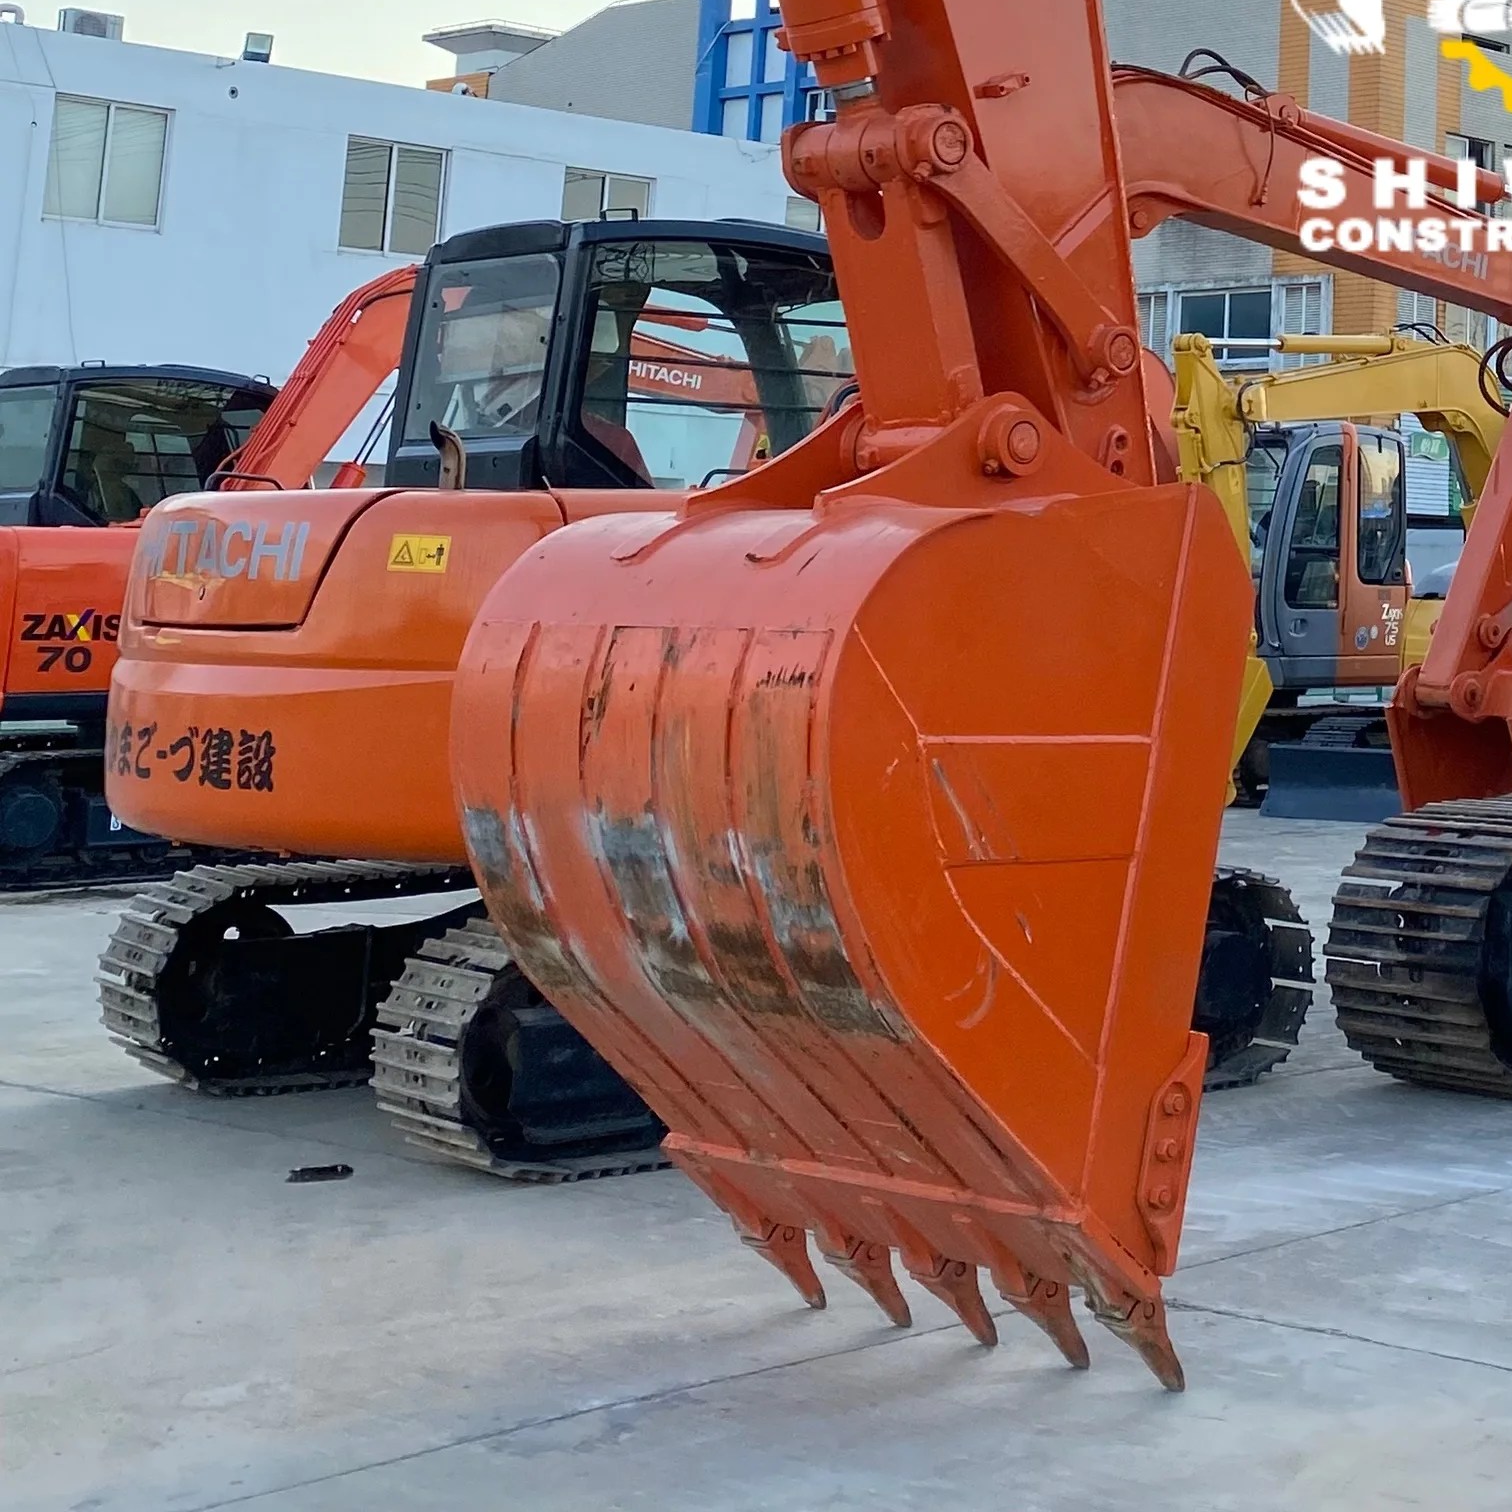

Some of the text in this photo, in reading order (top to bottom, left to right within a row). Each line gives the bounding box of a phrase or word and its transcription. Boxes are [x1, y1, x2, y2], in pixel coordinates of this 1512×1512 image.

[628, 359, 702, 390] HITACHI
[145, 520, 311, 582] HITACHI
[21, 608, 122, 642] ZAXIS
[1384, 621, 1400, 635] 75
[1384, 634, 1397, 646] US
[36, 646, 92, 673] 70
